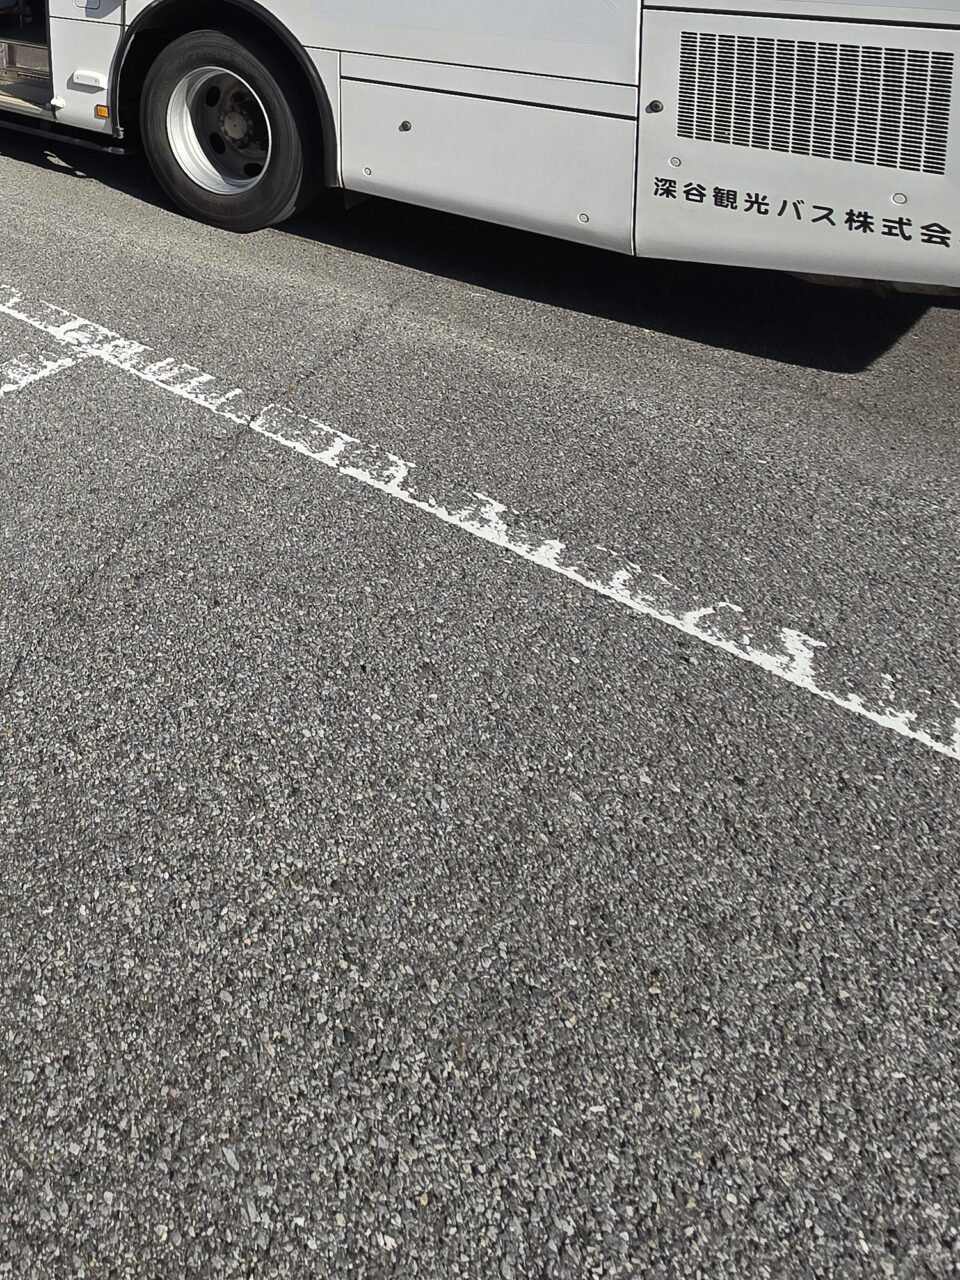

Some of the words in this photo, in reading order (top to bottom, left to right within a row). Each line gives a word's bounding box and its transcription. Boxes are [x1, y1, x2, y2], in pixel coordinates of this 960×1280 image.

[652, 176, 952, 248] 深谷観光バス株式会
